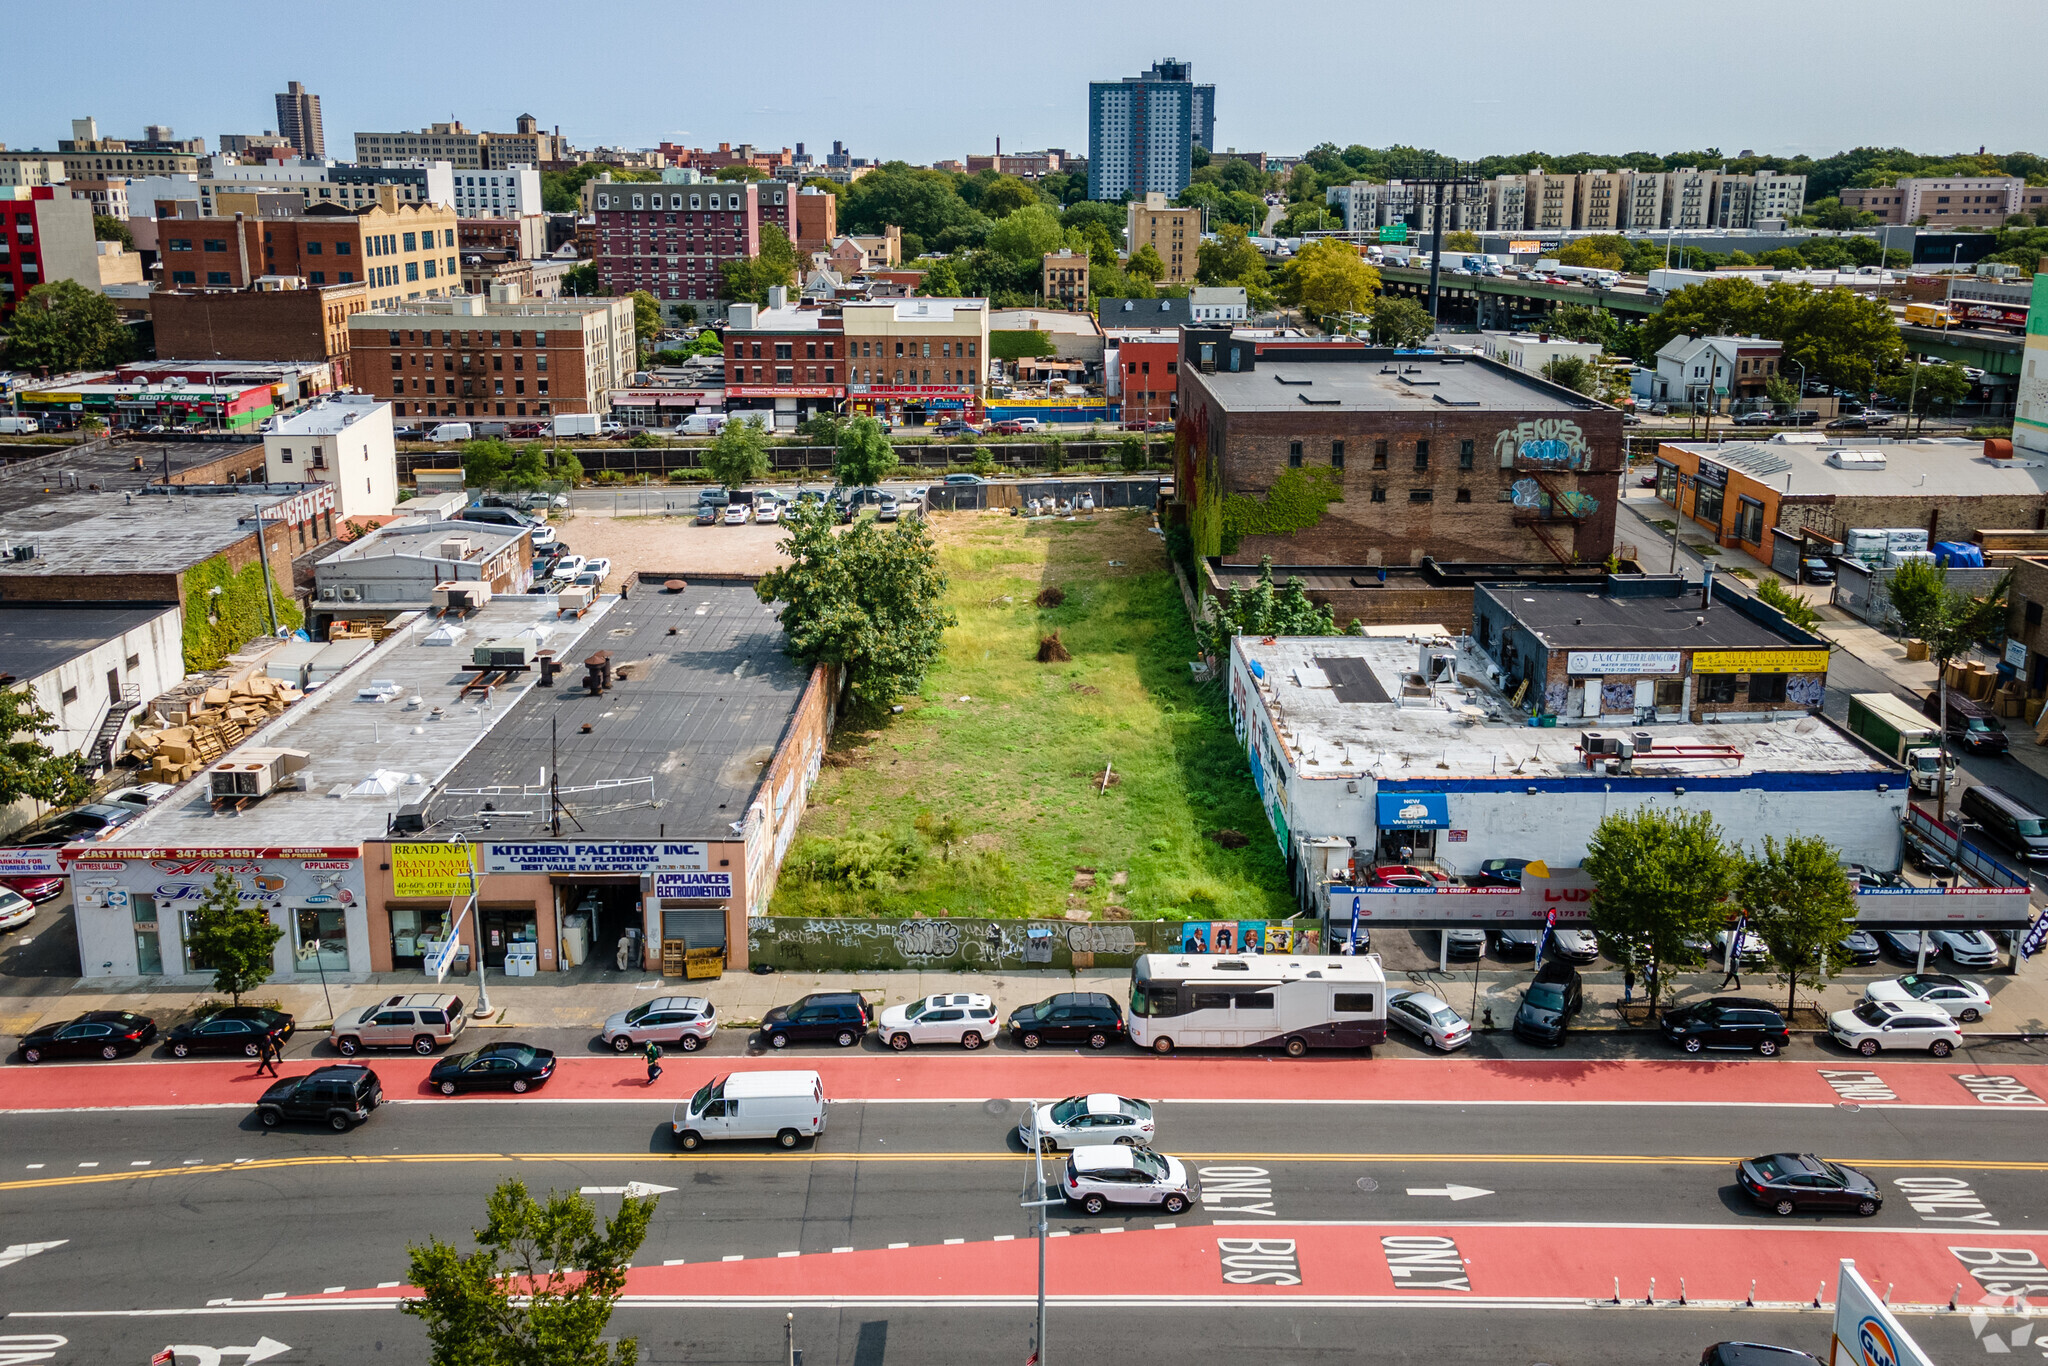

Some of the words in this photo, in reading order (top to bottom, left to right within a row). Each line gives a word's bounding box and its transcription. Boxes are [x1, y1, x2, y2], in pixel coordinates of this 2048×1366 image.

[1593, 653, 1620, 662] EXACT
[1724, 652, 1766, 660] MUFFLER
[86, 850, 117, 858] EASY
[118, 850, 168, 858] FINANCE
[176, 849, 256, 858] 347-663-1691
[394, 845, 440, 854] BRAND
[444, 844, 474, 854] NEW
[492, 846, 569, 856] KITCHEN
[575, 845, 658, 855] FACTORY
[664, 845, 700, 855] INC.
[75, 862, 101, 870] MATTRESS
[102, 862, 123, 870] GALLERY
[151, 858, 263, 876] Alexis
[304, 862, 350, 870] APPLIANCES
[396, 860, 436, 868] BRAND
[438, 860, 470, 868] NAME
[396, 868, 471, 878] APPLIANCES
[656, 874, 729, 884] APPLIANCES
[656, 886, 731, 898] ELECTRODOMESTICOS
[1817, 1069, 1898, 1101] ONLY
[1958, 1074, 2046, 1104] BUS
[1198, 1166, 1276, 1216] ONLY
[1893, 1177, 2000, 1226] ONLY
[1217, 1238, 1302, 1286] BUS
[1381, 1236, 1471, 1292] ONLY
[1947, 1246, 2048, 1297] BUS
